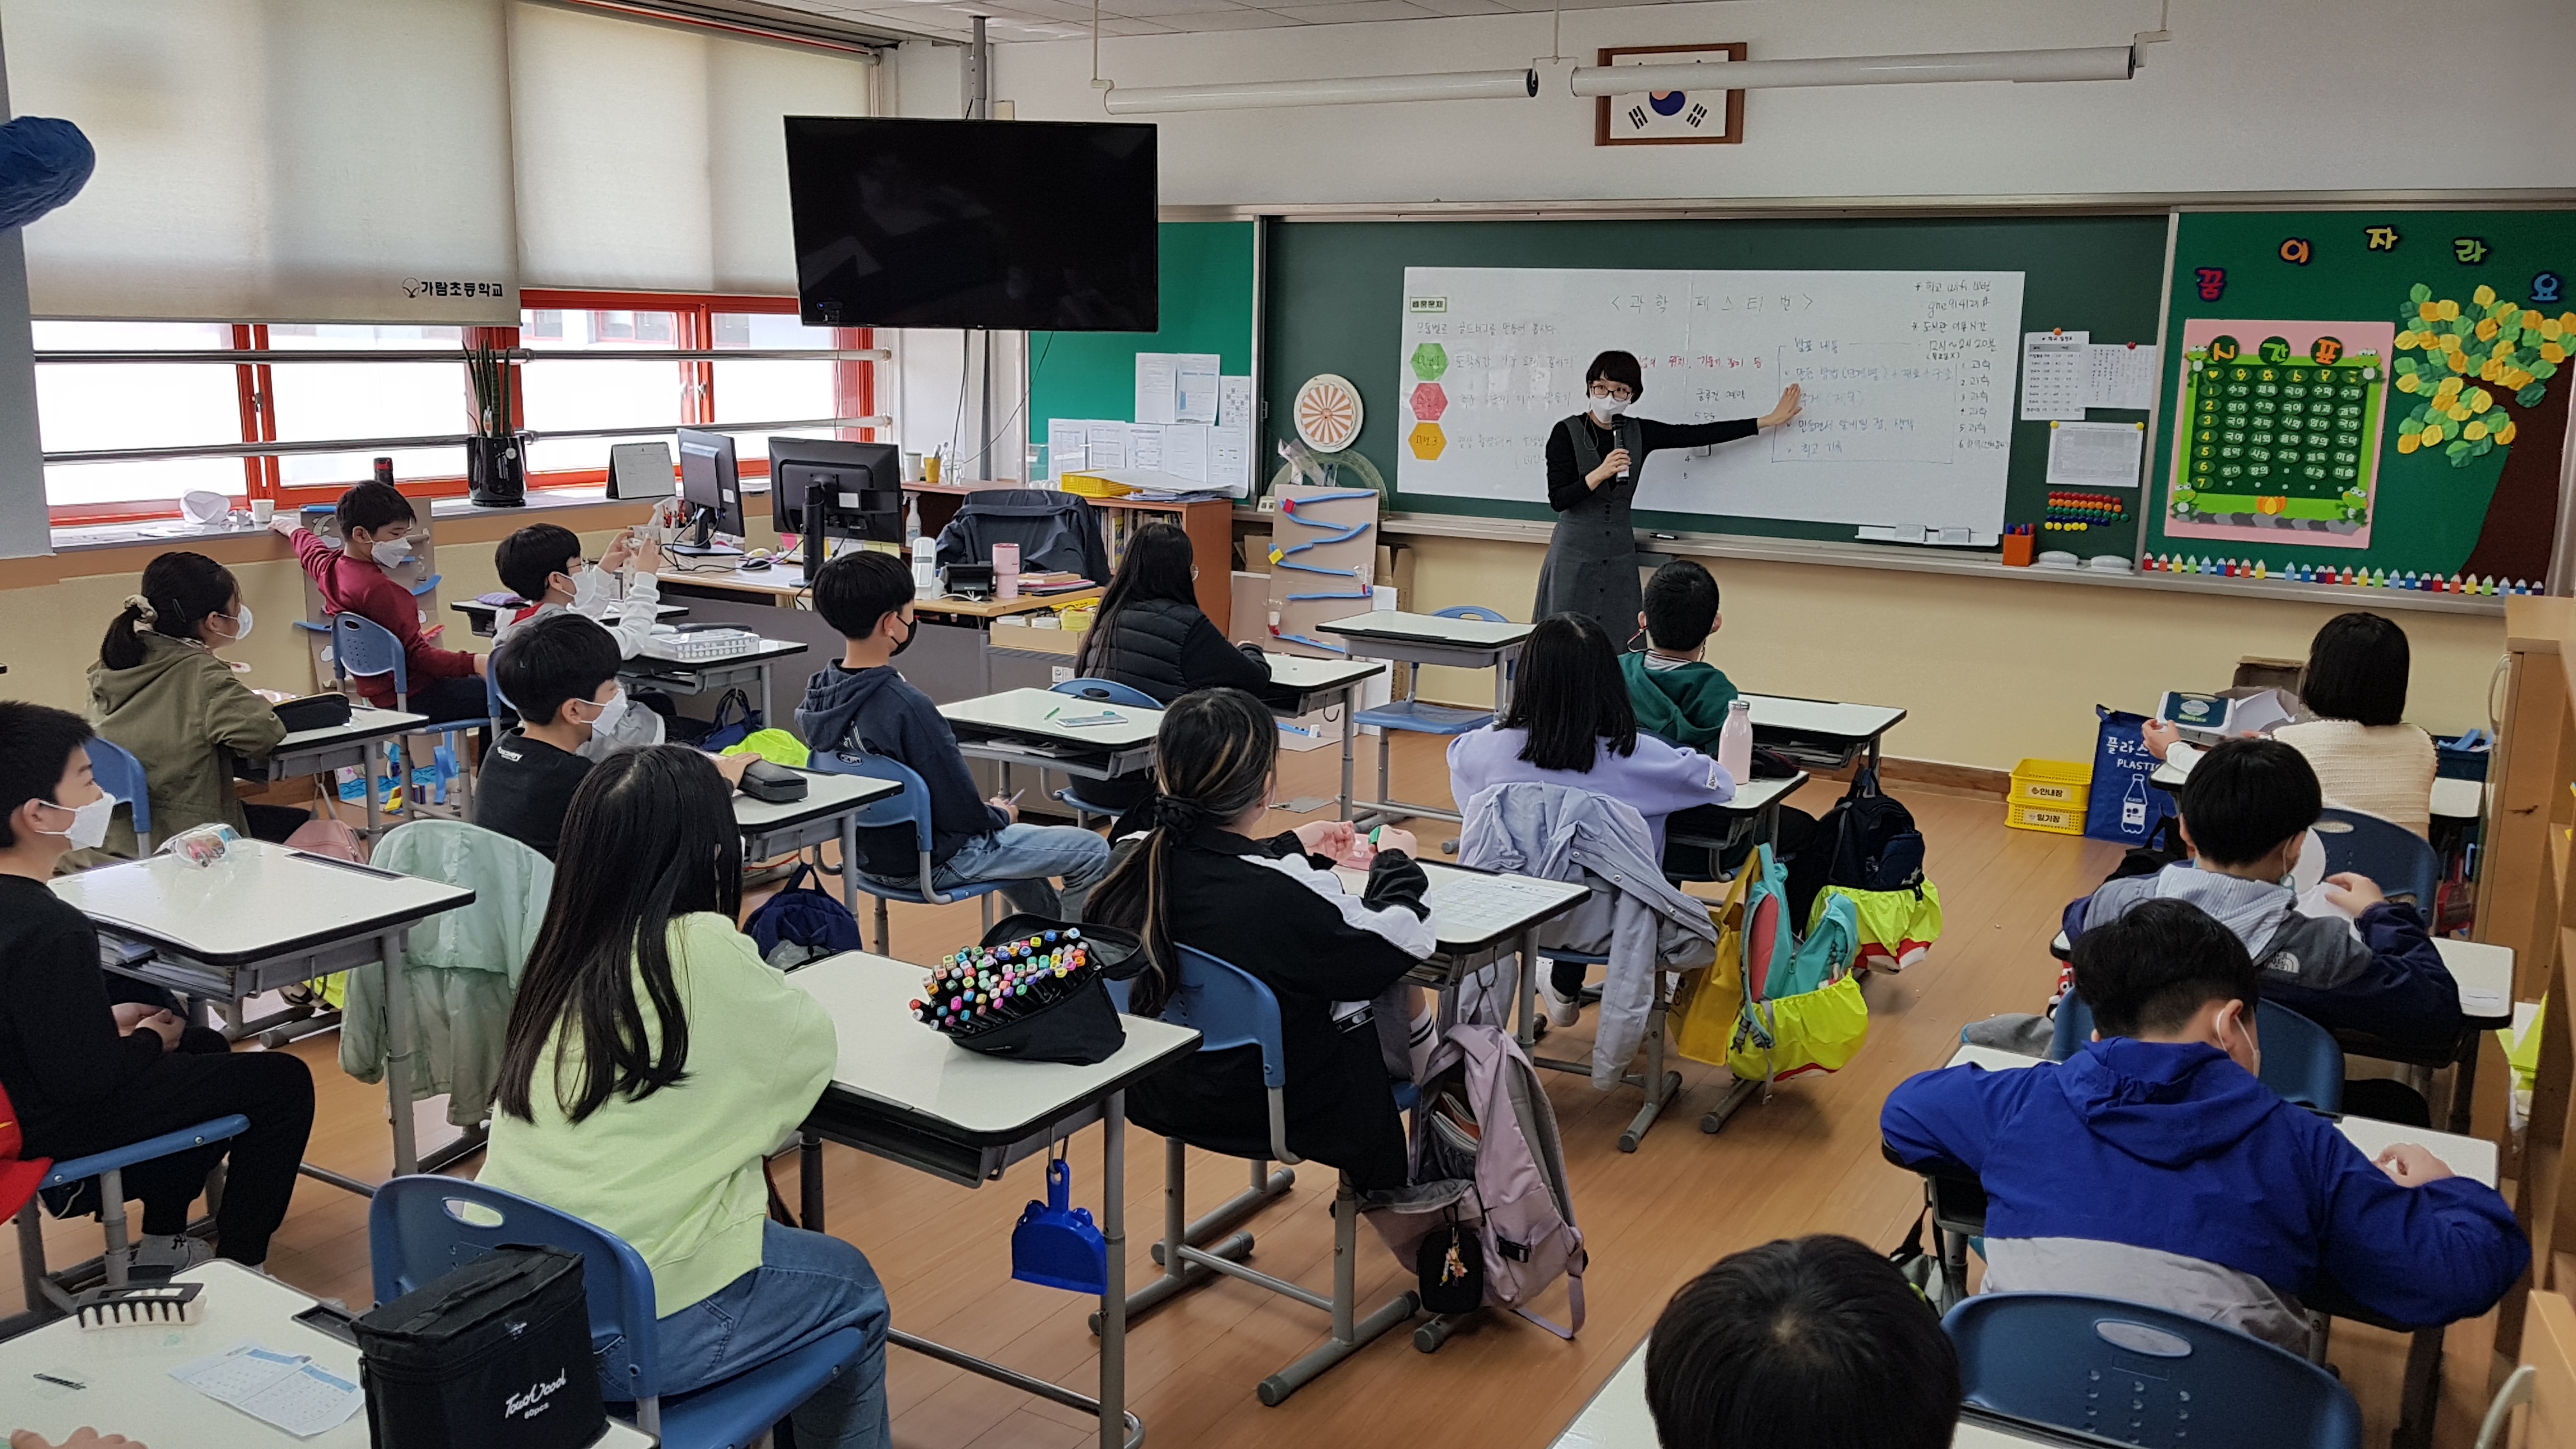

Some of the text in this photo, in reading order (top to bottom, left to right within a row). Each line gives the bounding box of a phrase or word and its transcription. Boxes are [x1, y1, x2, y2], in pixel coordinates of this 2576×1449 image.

[420, 281, 503, 298] 가람초등학교
[1924, 321, 1947, 333] 도서관
[2228, 385, 2248, 395] 수학
[2258, 385, 2276, 394] 체육
[2285, 386, 2304, 395] 국어
[2314, 386, 2333, 396] 수학
[2341, 388, 2360, 398] 수학
[2205, 401, 2213, 410] 2
[2228, 402, 2246, 411] 영어
[2255, 401, 2274, 411] 수학
[2339, 406, 2359, 416] 과학
[2204, 415, 2358, 429] 3 국어 과학 사회 영어 국어
[2202, 431, 2358, 446] 4 국어 사회 음악 창의 도덕
[2202, 447, 2356, 462] 5 음악 사회 과학 체육 미술
[2200, 461, 2354, 478] 6 영어 창의 실과 미술
[2198, 478, 2205, 488] 7
[2106, 737, 2149, 756] 플라스
[2039, 788, 2063, 798] 안내장
[2037, 813, 2060, 824] 일기장
[524, 1402, 549, 1419] 60pcs
